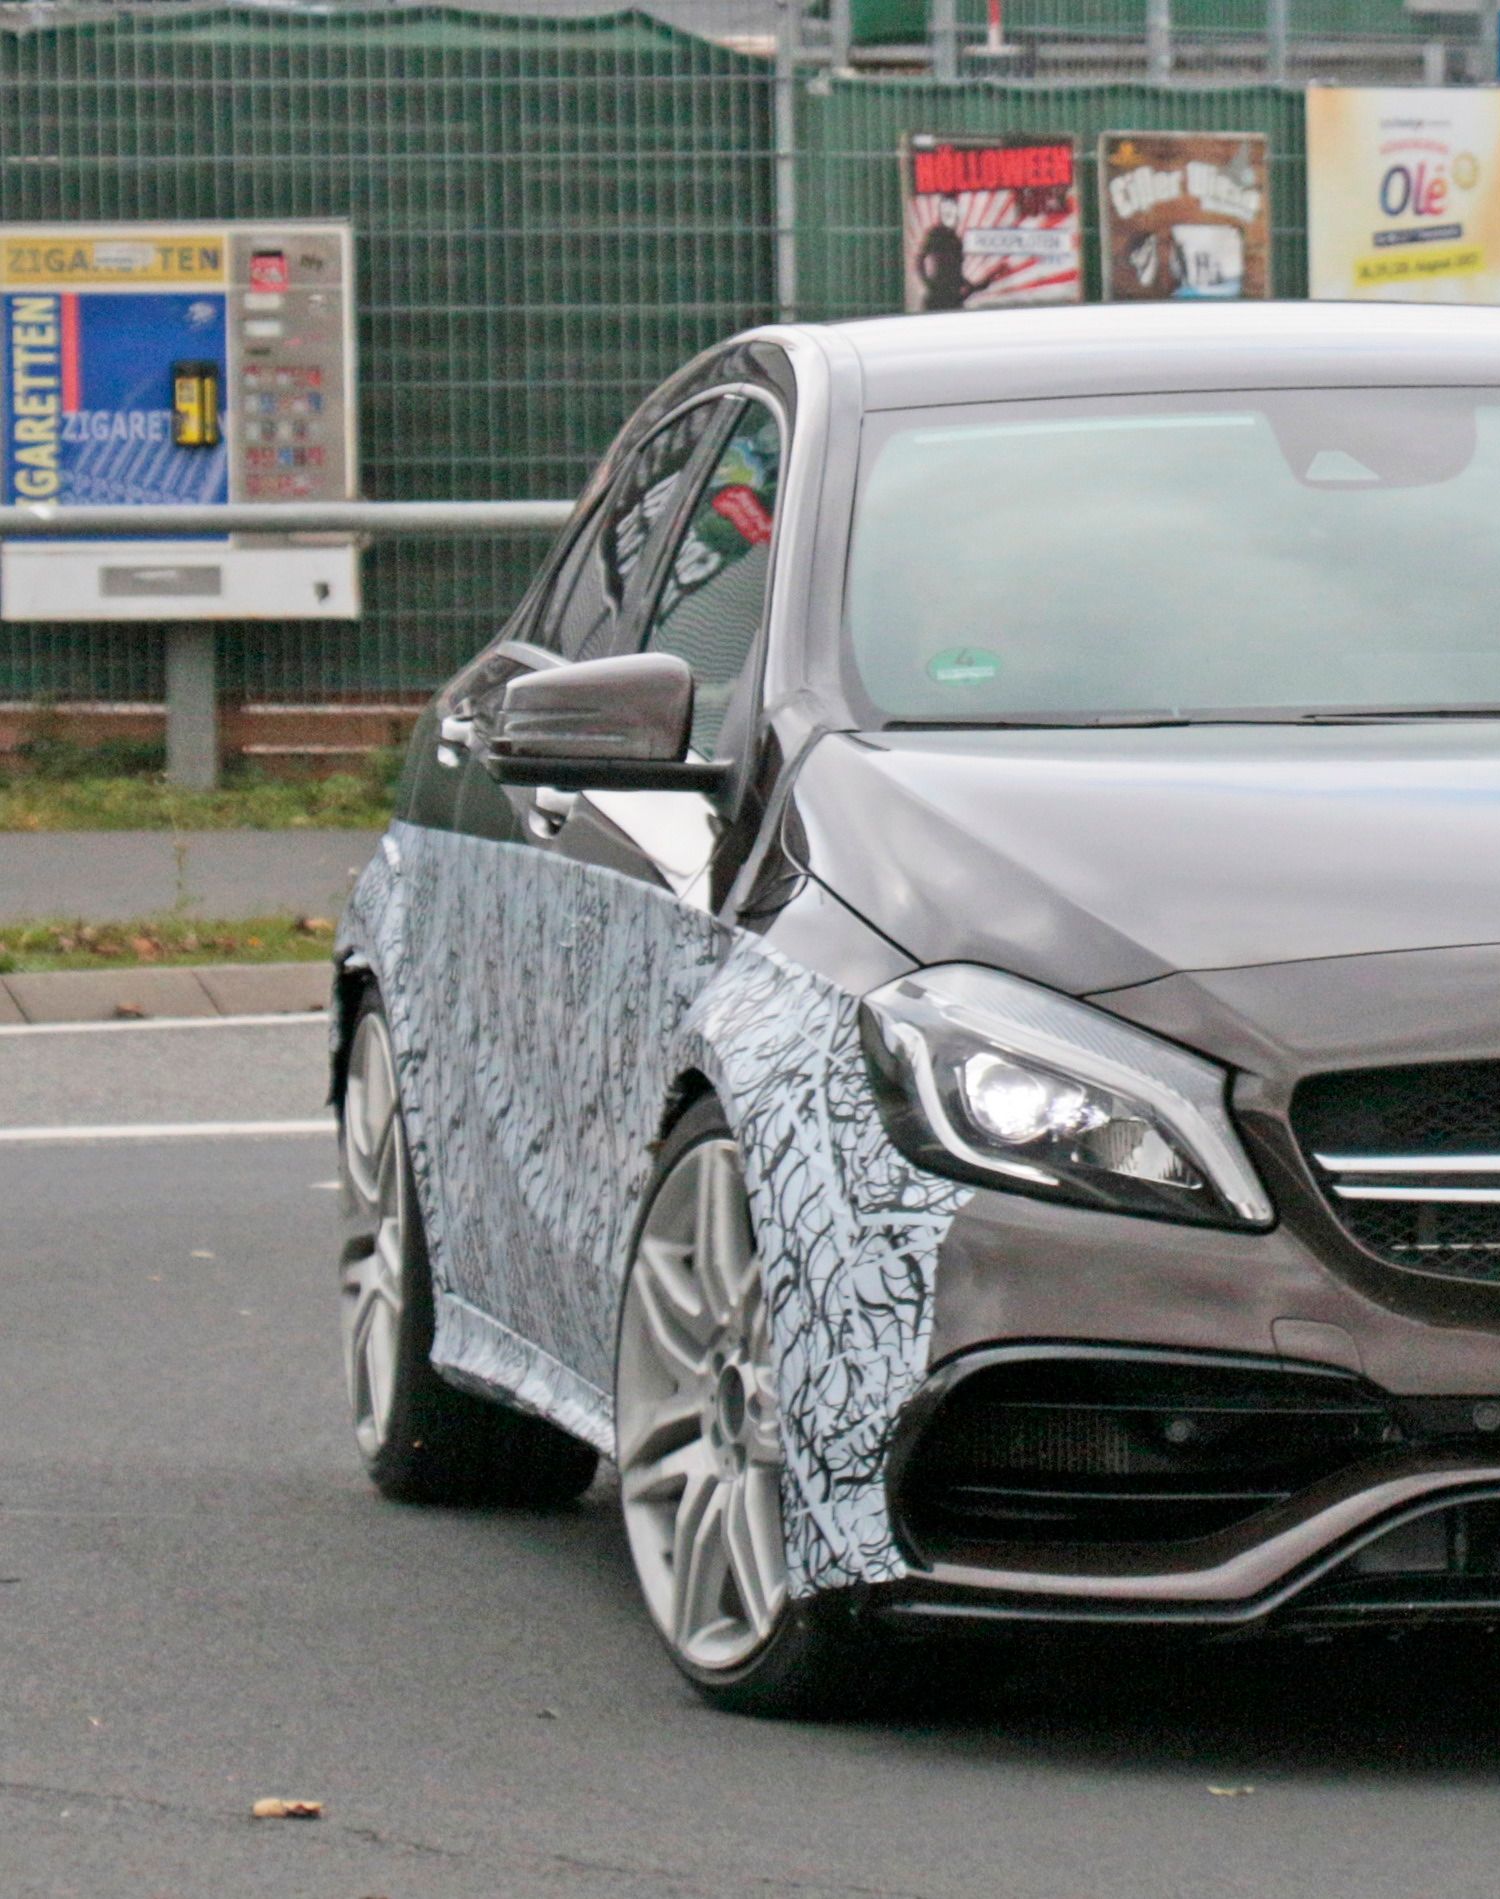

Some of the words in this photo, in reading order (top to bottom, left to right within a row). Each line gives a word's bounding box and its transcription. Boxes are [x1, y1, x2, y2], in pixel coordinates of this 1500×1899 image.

[1381, 160, 1448, 217] Olé
[8, 246, 220, 273] ZIGATEN
[12, 297, 58, 505] GARETTEN
